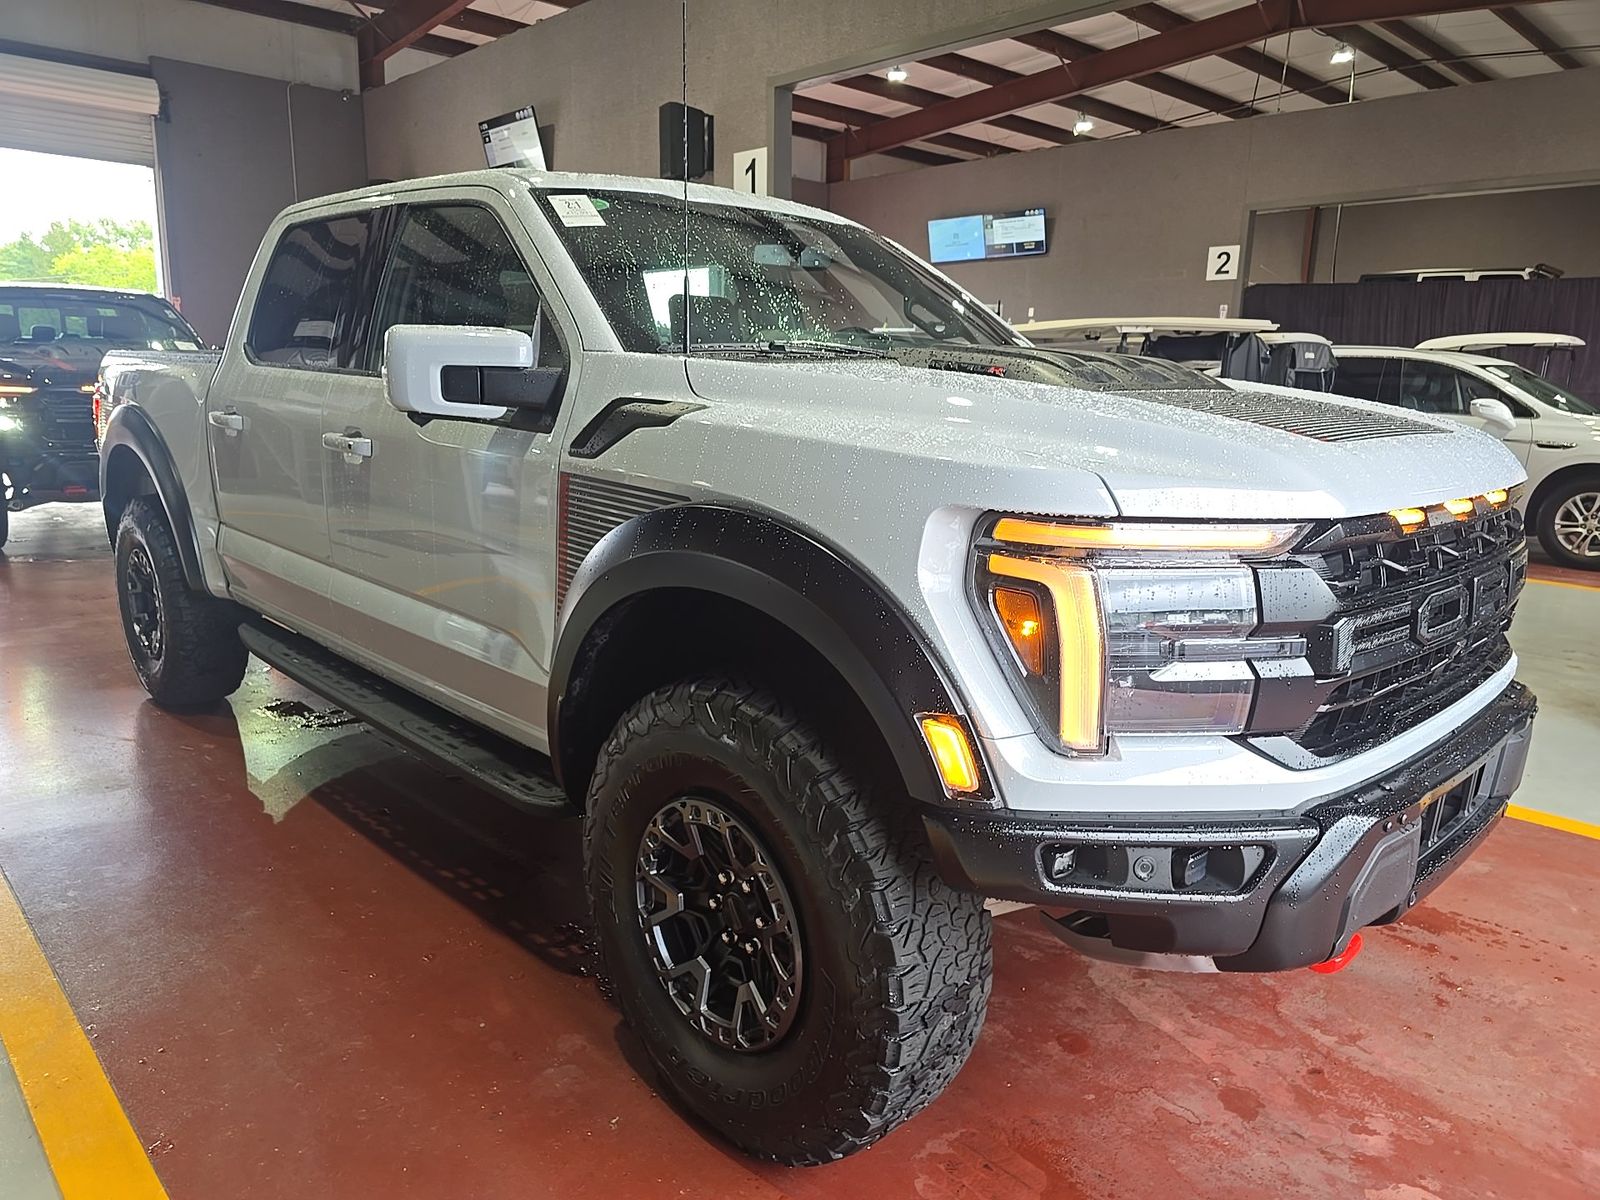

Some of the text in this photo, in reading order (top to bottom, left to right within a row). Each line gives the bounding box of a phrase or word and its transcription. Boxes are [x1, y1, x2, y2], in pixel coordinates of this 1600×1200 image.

[745, 157, 756, 194] 1
[1214, 251, 1231, 276] 2
[1333, 547, 1529, 676] FORD
